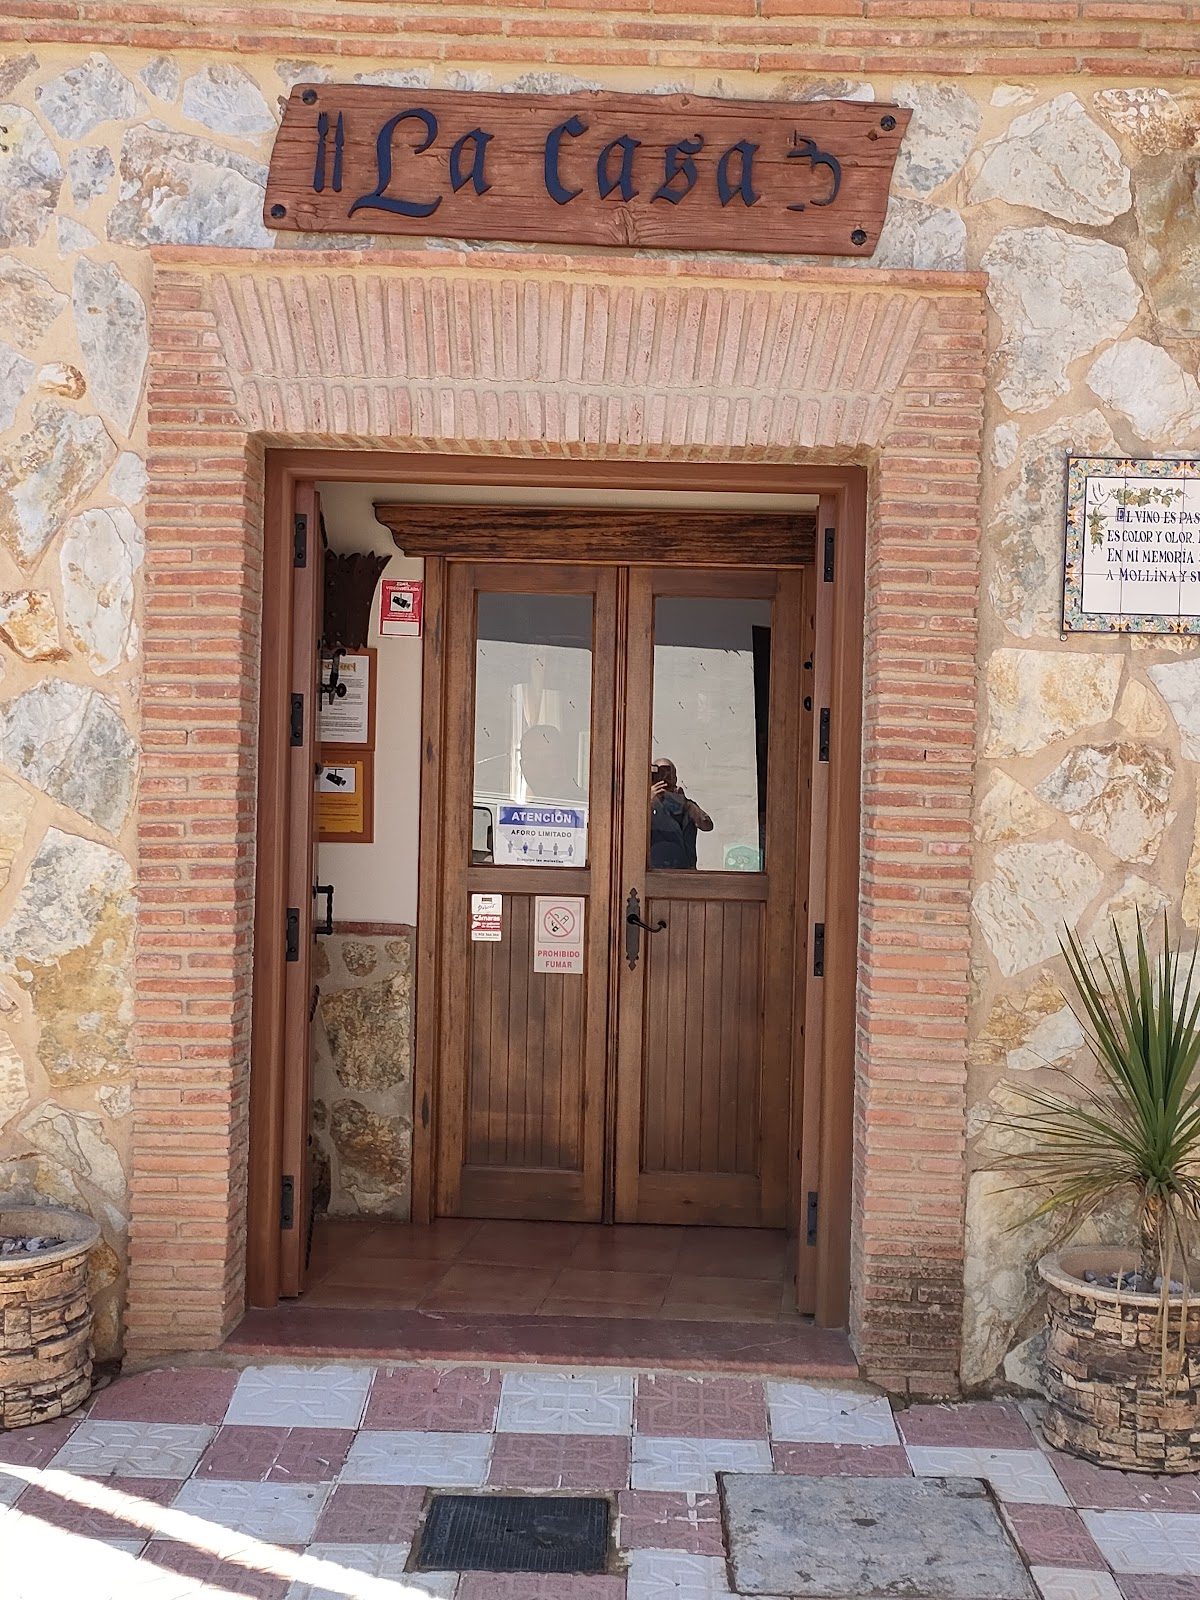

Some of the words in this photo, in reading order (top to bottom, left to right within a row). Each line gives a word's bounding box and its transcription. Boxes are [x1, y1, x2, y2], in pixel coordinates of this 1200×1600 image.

[348, 107, 493, 218] La
[543, 113, 763, 208] Casa
[1135, 508, 1160, 524] VINO
[1164, 511, 1177, 524] ES
[1107, 529, 1121, 542] ES
[1122, 530, 1153, 543] COLOR
[1155, 531, 1162, 544] Y
[1165, 531, 1195, 544] OLOR.
[1107, 548, 1122, 562] EN
[1126, 548, 1139, 562] MI
[1142, 549, 1194, 563] MEMORIA
[1106, 569, 1114, 581] A
[1119, 567, 1177, 582] MOLLINA
[1180, 570, 1187, 583] Y
[511, 811, 572, 824] ATENCIÓN
[511, 829, 536, 837] AFORO
[538, 830, 572, 838] LIMITADO
[537, 950, 580, 958] PROHIBIDO
